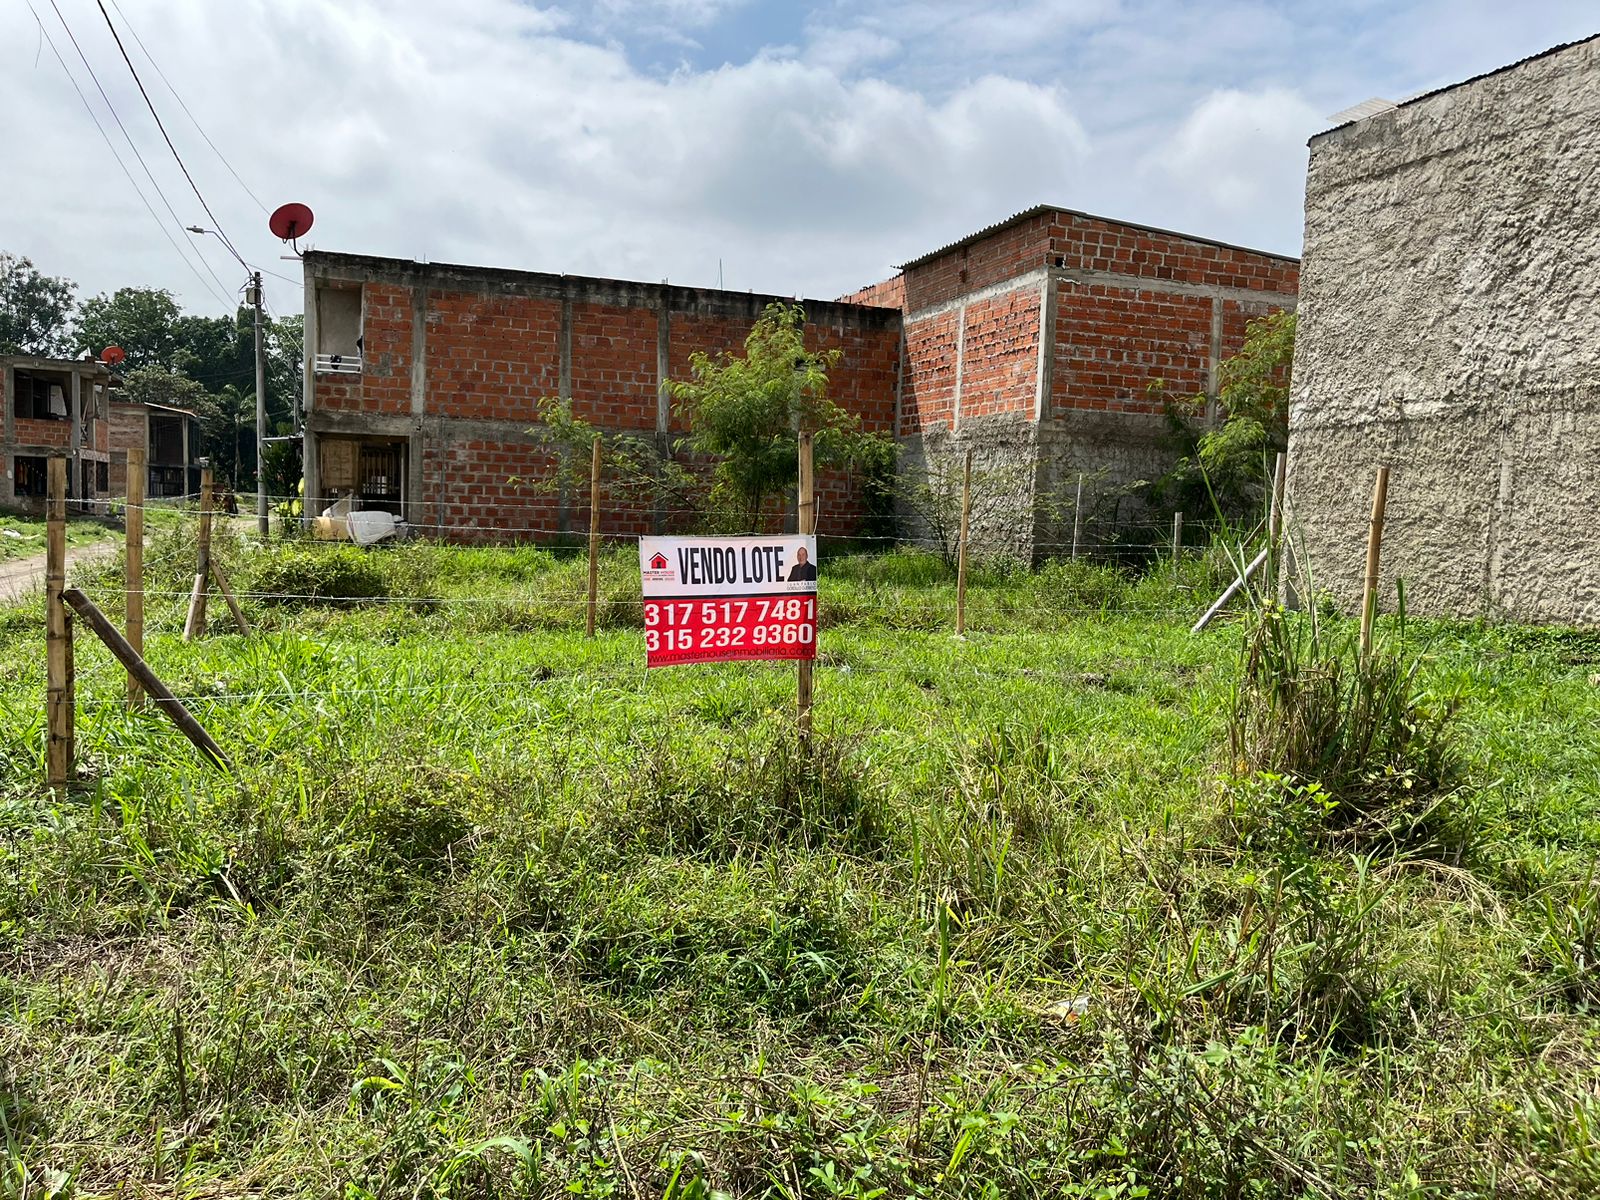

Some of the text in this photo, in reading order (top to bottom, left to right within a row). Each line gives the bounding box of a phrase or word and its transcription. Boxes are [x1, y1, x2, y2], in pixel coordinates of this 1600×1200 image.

[677, 546, 785, 585] VENDO LOTE
[645, 599, 814, 626] 317 517 7481
[646, 623, 813, 651] 315 232 9360
